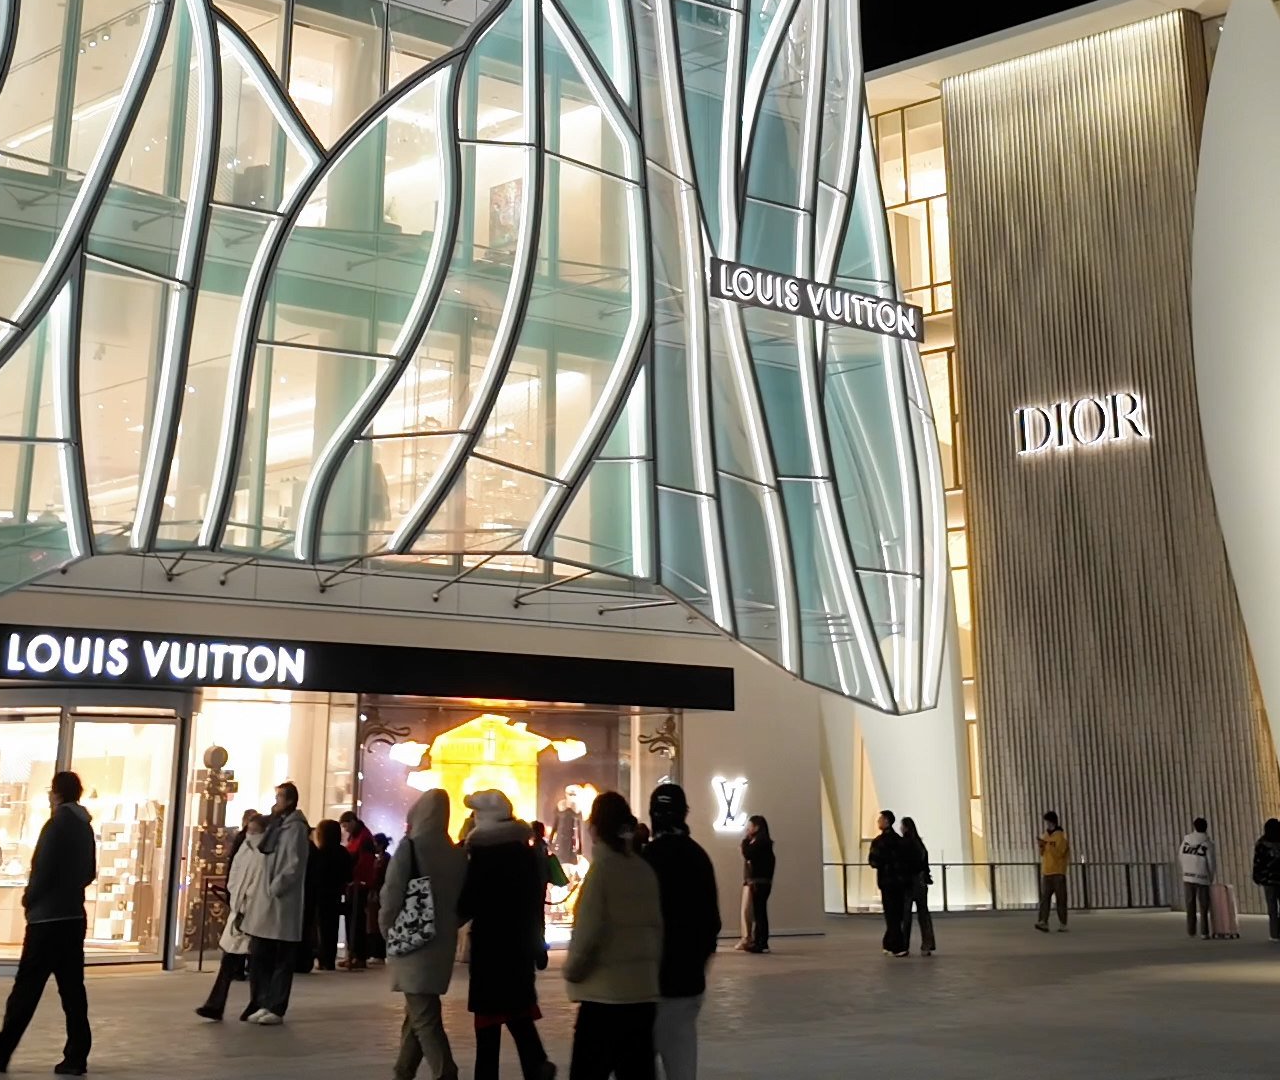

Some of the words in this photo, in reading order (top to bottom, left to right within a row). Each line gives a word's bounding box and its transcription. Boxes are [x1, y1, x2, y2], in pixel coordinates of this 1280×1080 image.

[720, 264, 801, 311] LOUIS
[806, 284, 917, 338] VUITTON
[1013, 392, 1151, 455] DIOR
[7, 633, 129, 676] LOUIS
[143, 640, 305, 684] VUITTON
